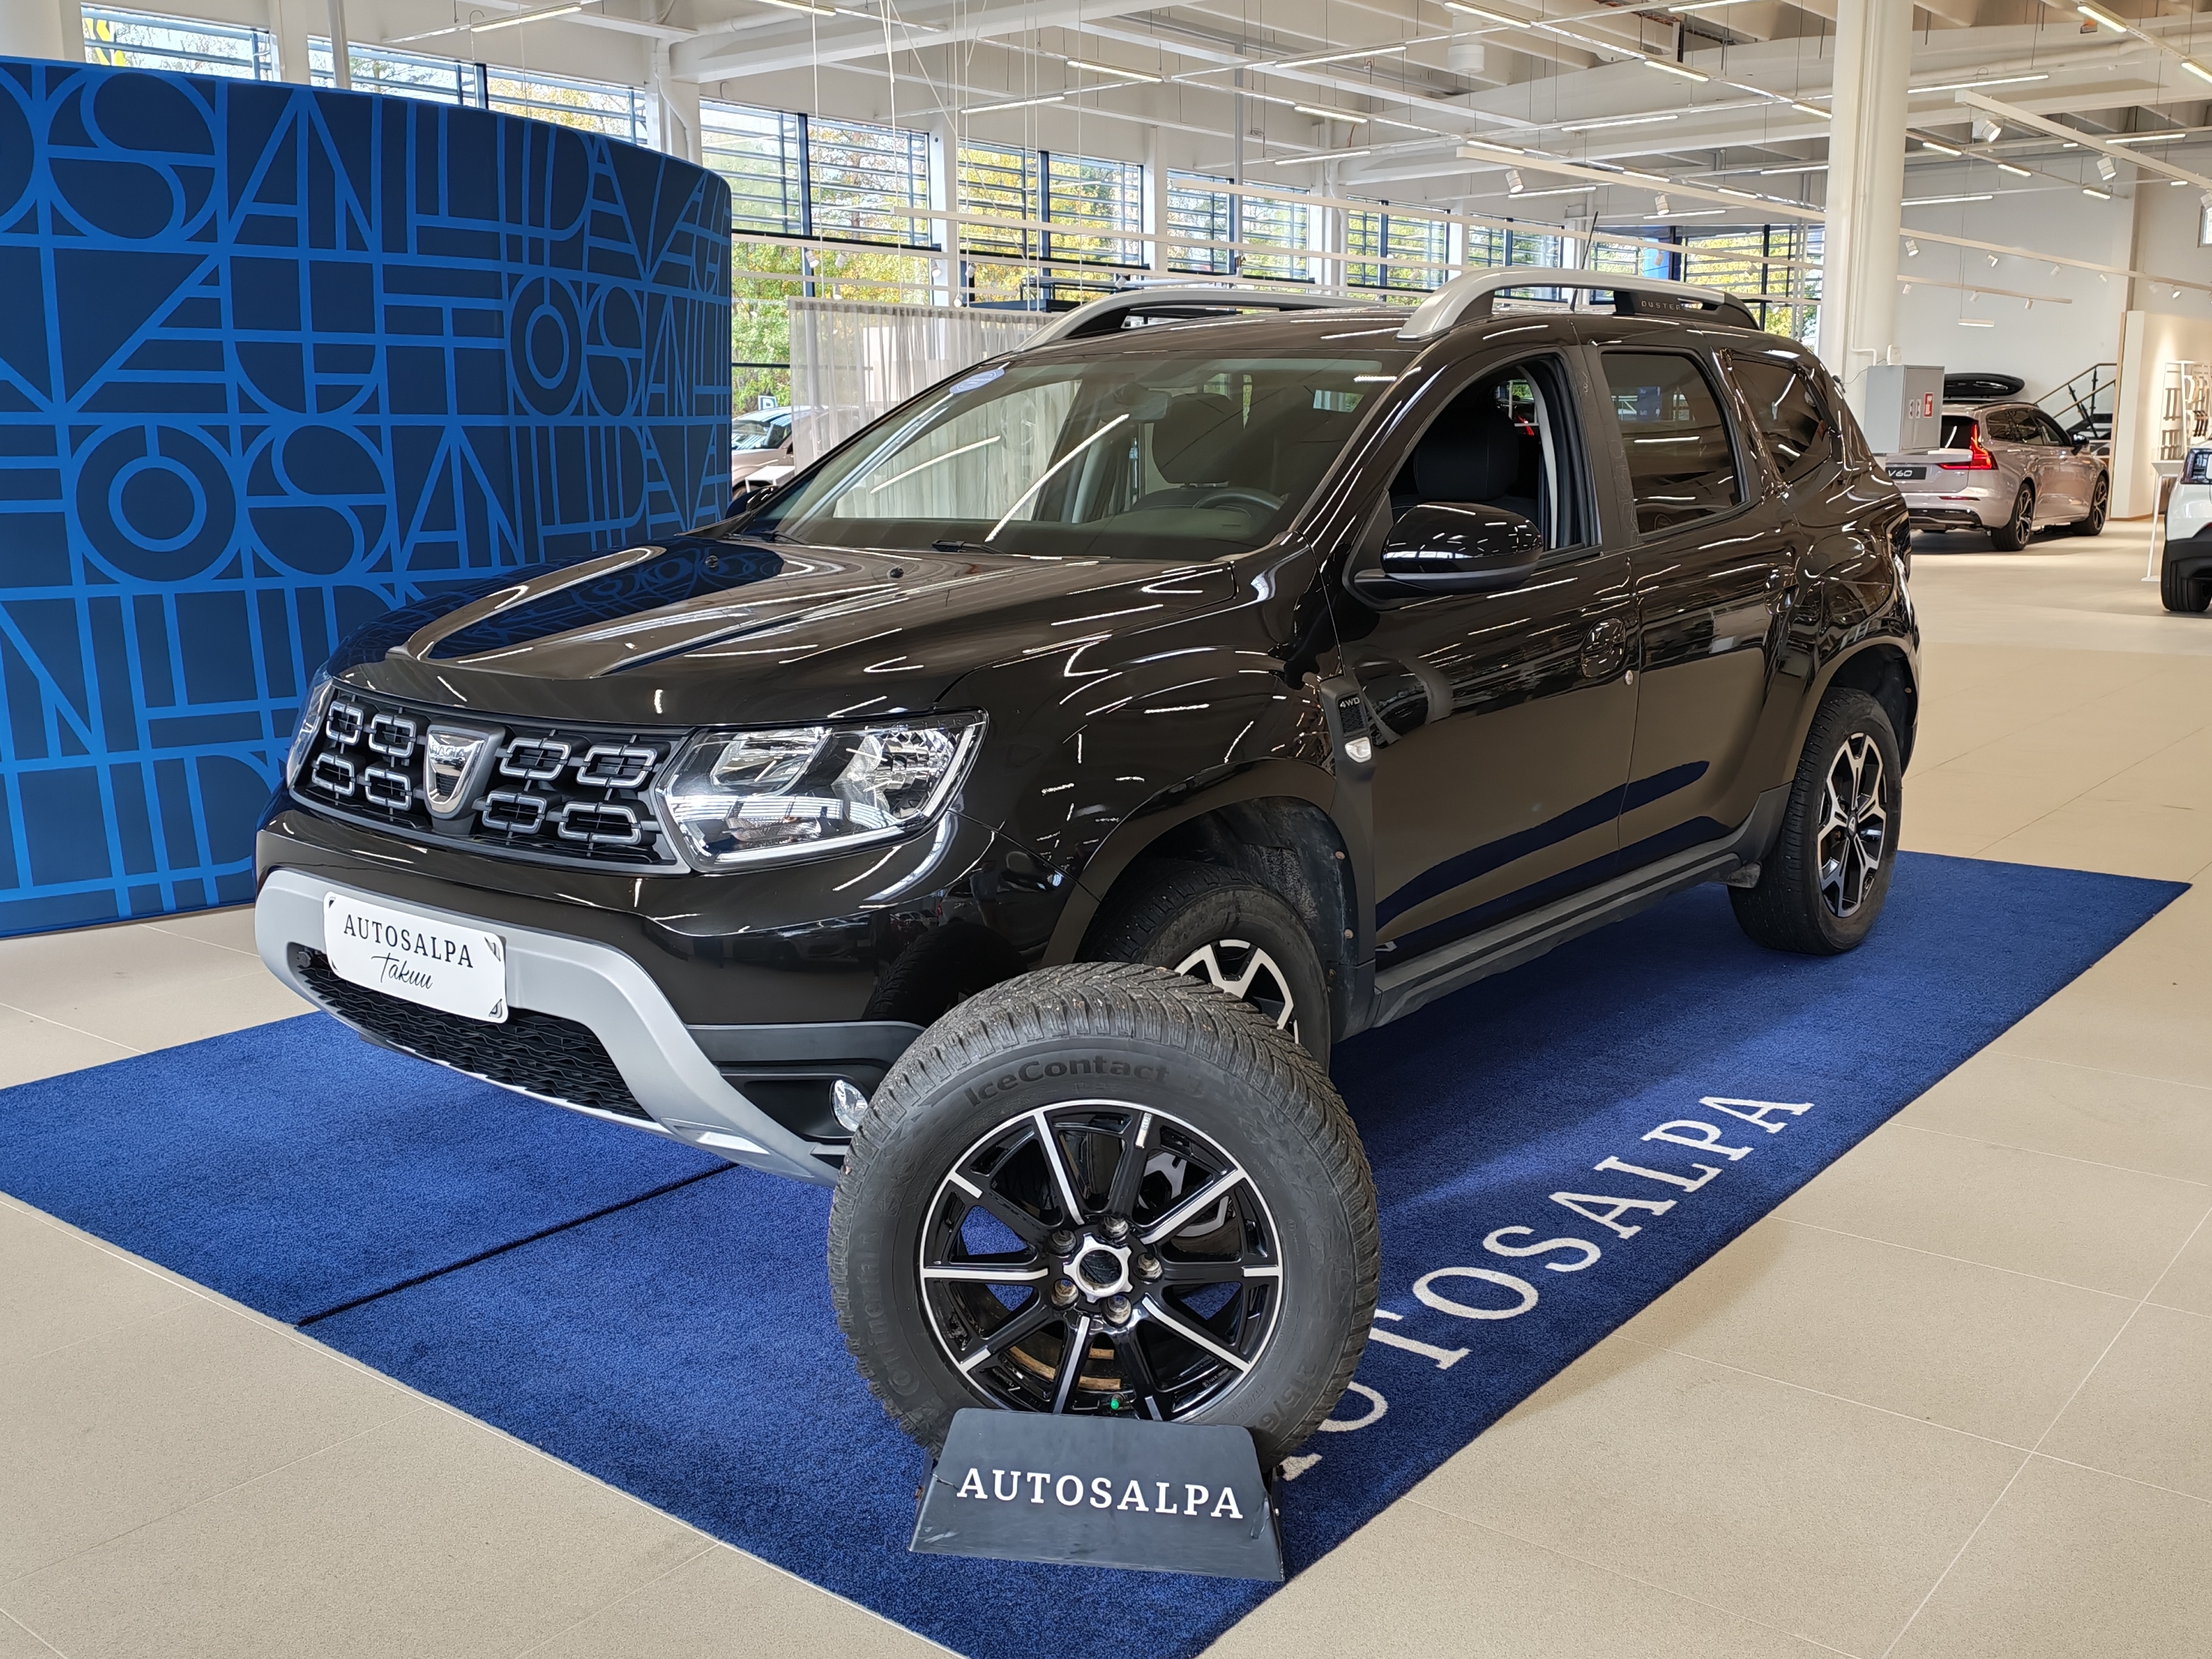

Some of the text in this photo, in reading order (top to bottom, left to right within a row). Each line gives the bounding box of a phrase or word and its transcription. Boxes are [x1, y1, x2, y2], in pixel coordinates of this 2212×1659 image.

[1641, 300, 1681, 311] DUSTER
[1339, 697, 1360, 708] 4WD
[430, 744, 466, 757] DACIA
[343, 914, 474, 968] AUTOSALPA
[370, 952, 433, 989] Takuu
[963, 1055, 1170, 1107] IceContact
[1280, 1096, 1815, 1481] TOSALPA
[956, 1468, 1243, 1519] AUTOSALPA
